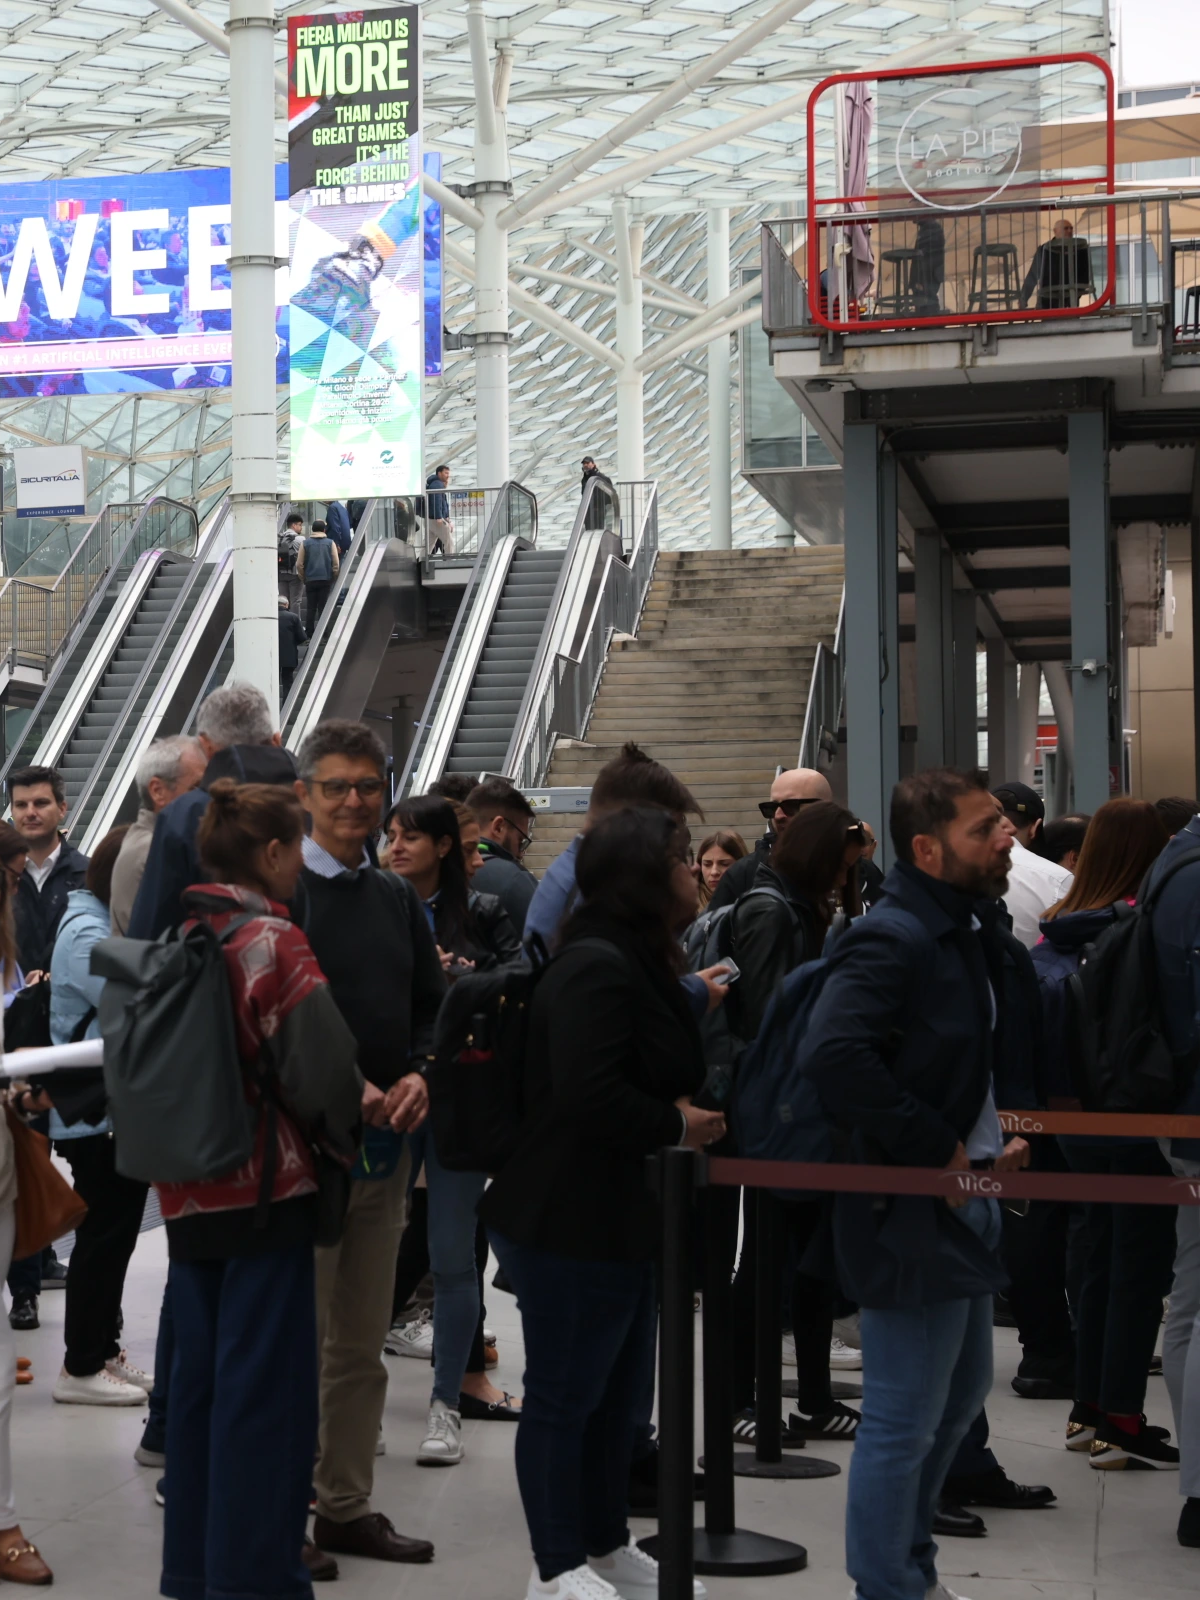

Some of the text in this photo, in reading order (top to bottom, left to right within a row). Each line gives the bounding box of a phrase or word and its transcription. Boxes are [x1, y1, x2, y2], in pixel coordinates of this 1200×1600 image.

[297, 18, 408, 47] FIERA MILANO IS
[297, 40, 409, 98] MORE
[335, 101, 409, 124] THAN JUST
[313, 121, 410, 146] GREAT GAMES.
[356, 142, 409, 164] IT'S THE
[910, 133, 948, 160] LA
[316, 164, 410, 187] FORCE BEHIND
[310, 183, 410, 207] THE GAMES.
[12, 353, 29, 367] #1
[32, 348, 103, 365] ARTIFICIAL
[106, 344, 201, 362] INTELLIGENCE
